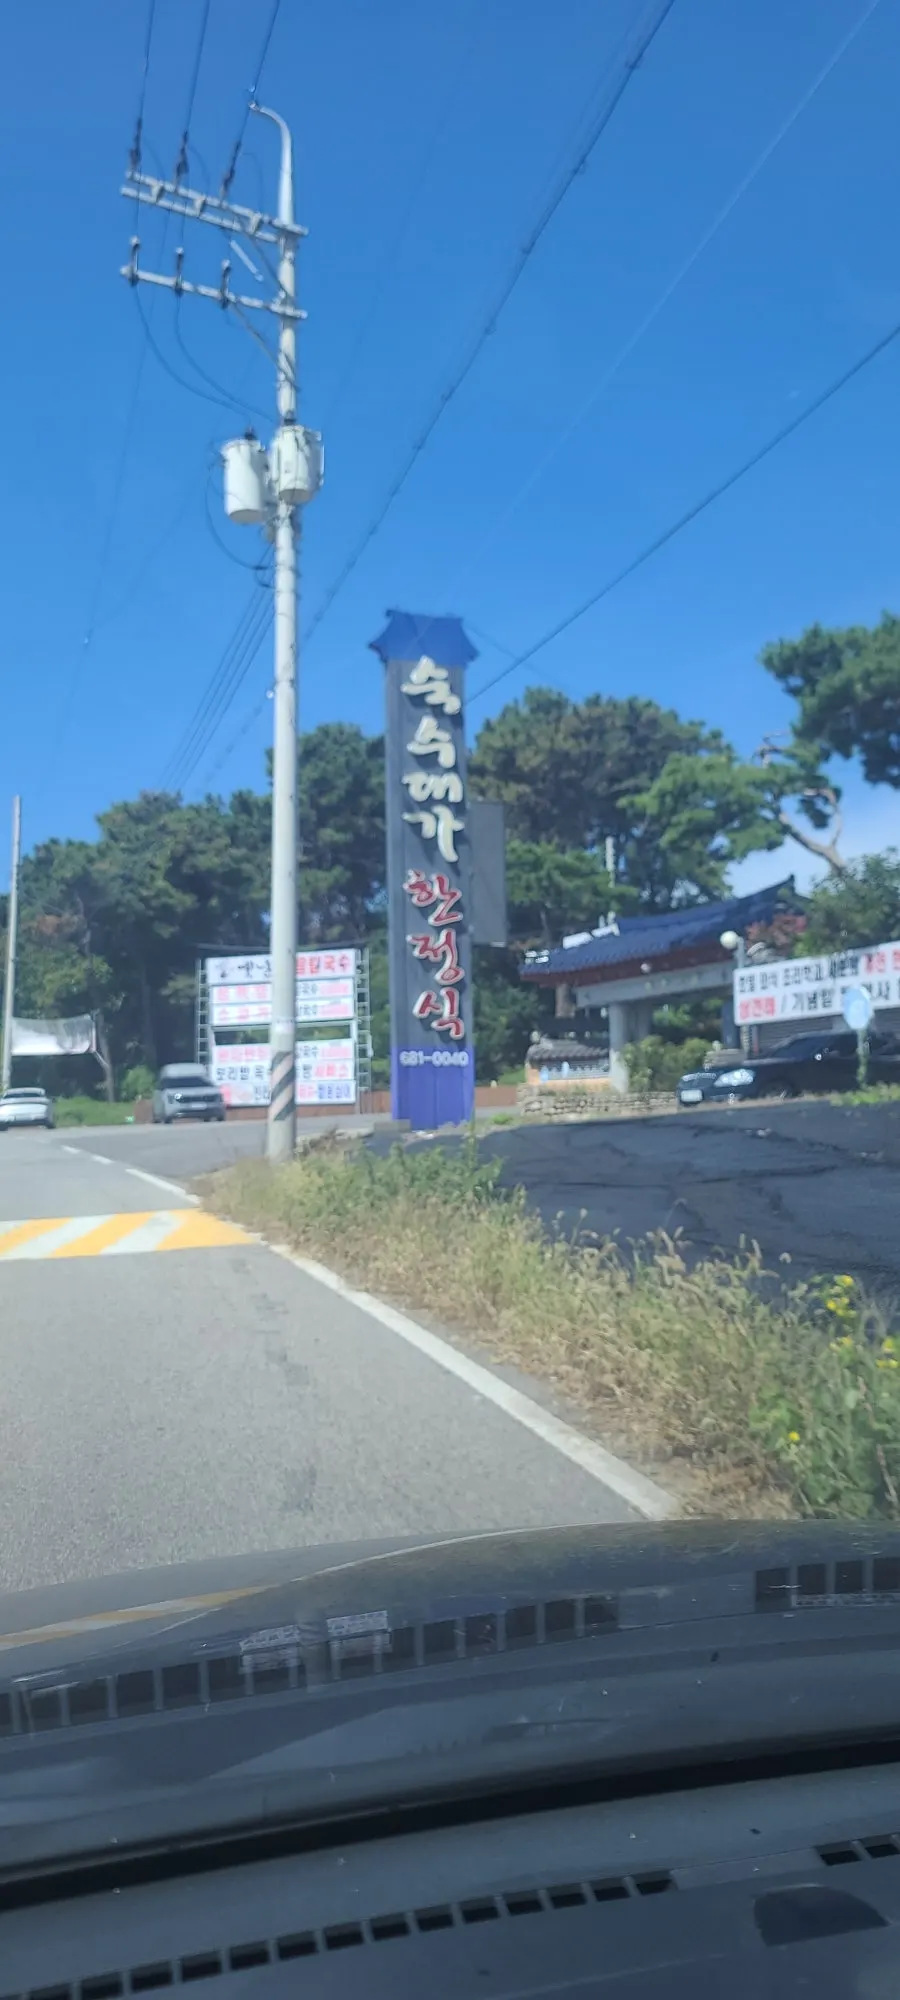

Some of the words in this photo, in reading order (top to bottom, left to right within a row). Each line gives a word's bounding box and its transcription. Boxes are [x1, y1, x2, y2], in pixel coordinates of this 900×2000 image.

[400, 654, 465, 863] 숙수대가
[403, 867, 465, 1041] 한정식
[216, 1065, 251, 1081] 보리밥
